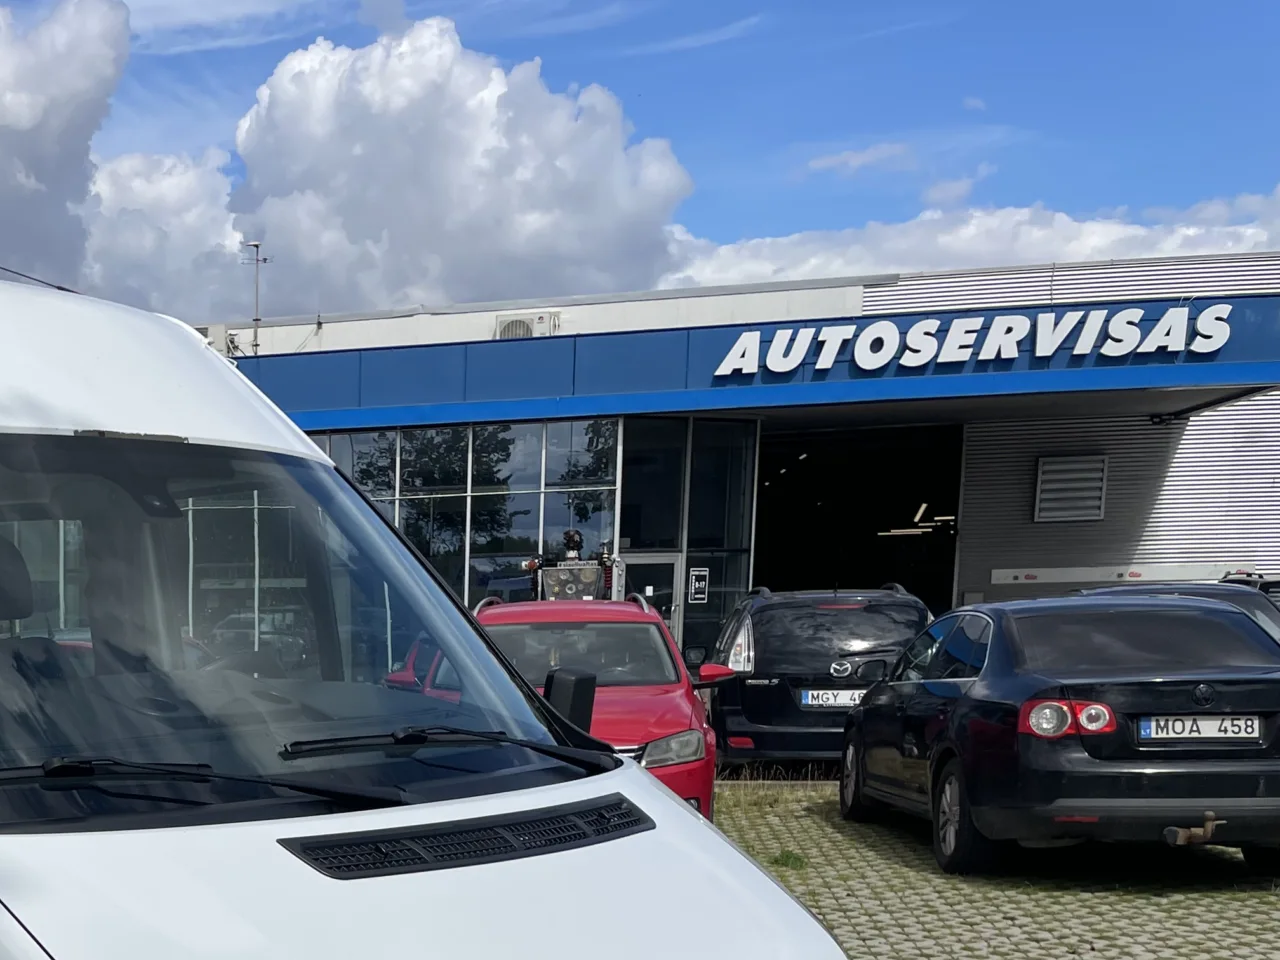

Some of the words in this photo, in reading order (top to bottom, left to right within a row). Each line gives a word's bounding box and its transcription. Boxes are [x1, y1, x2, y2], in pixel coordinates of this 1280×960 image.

[714, 304, 1233, 376] AUTOSERVISAS
[811, 692, 840, 703] MGY
[1155, 718, 1202, 735] MOA
[1218, 718, 1255, 735] 458
